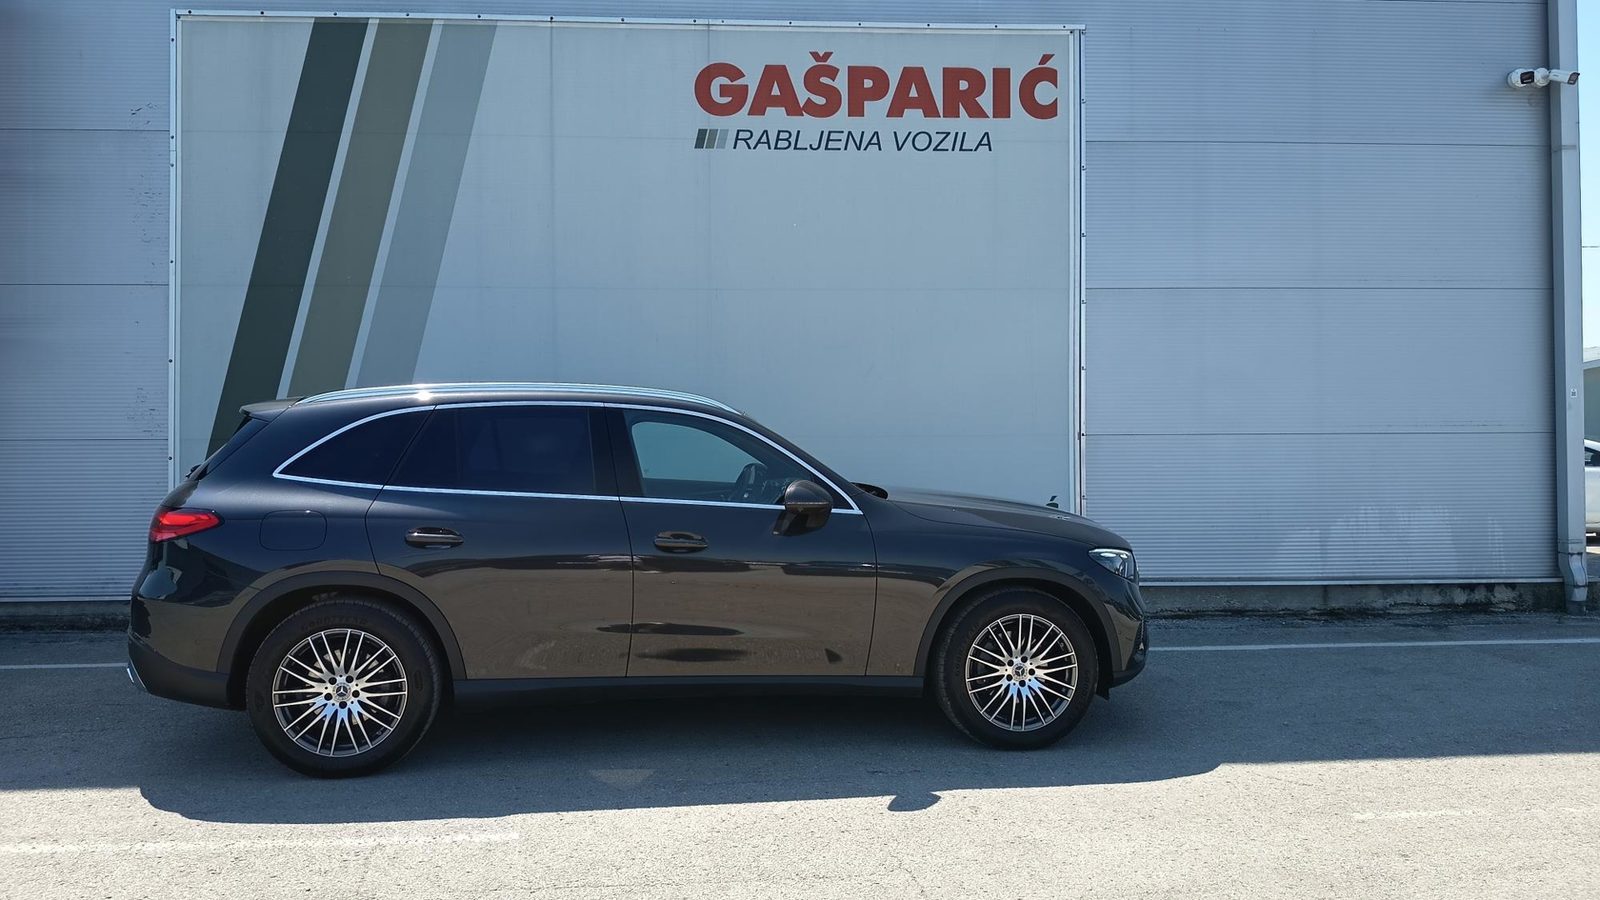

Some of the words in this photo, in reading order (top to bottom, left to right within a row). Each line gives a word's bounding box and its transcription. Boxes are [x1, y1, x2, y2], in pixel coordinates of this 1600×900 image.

[694, 51, 1059, 119] GAŠPARIĆ
[733, 128, 883, 151] RABLJENA
[893, 131, 993, 152] VOZILA
